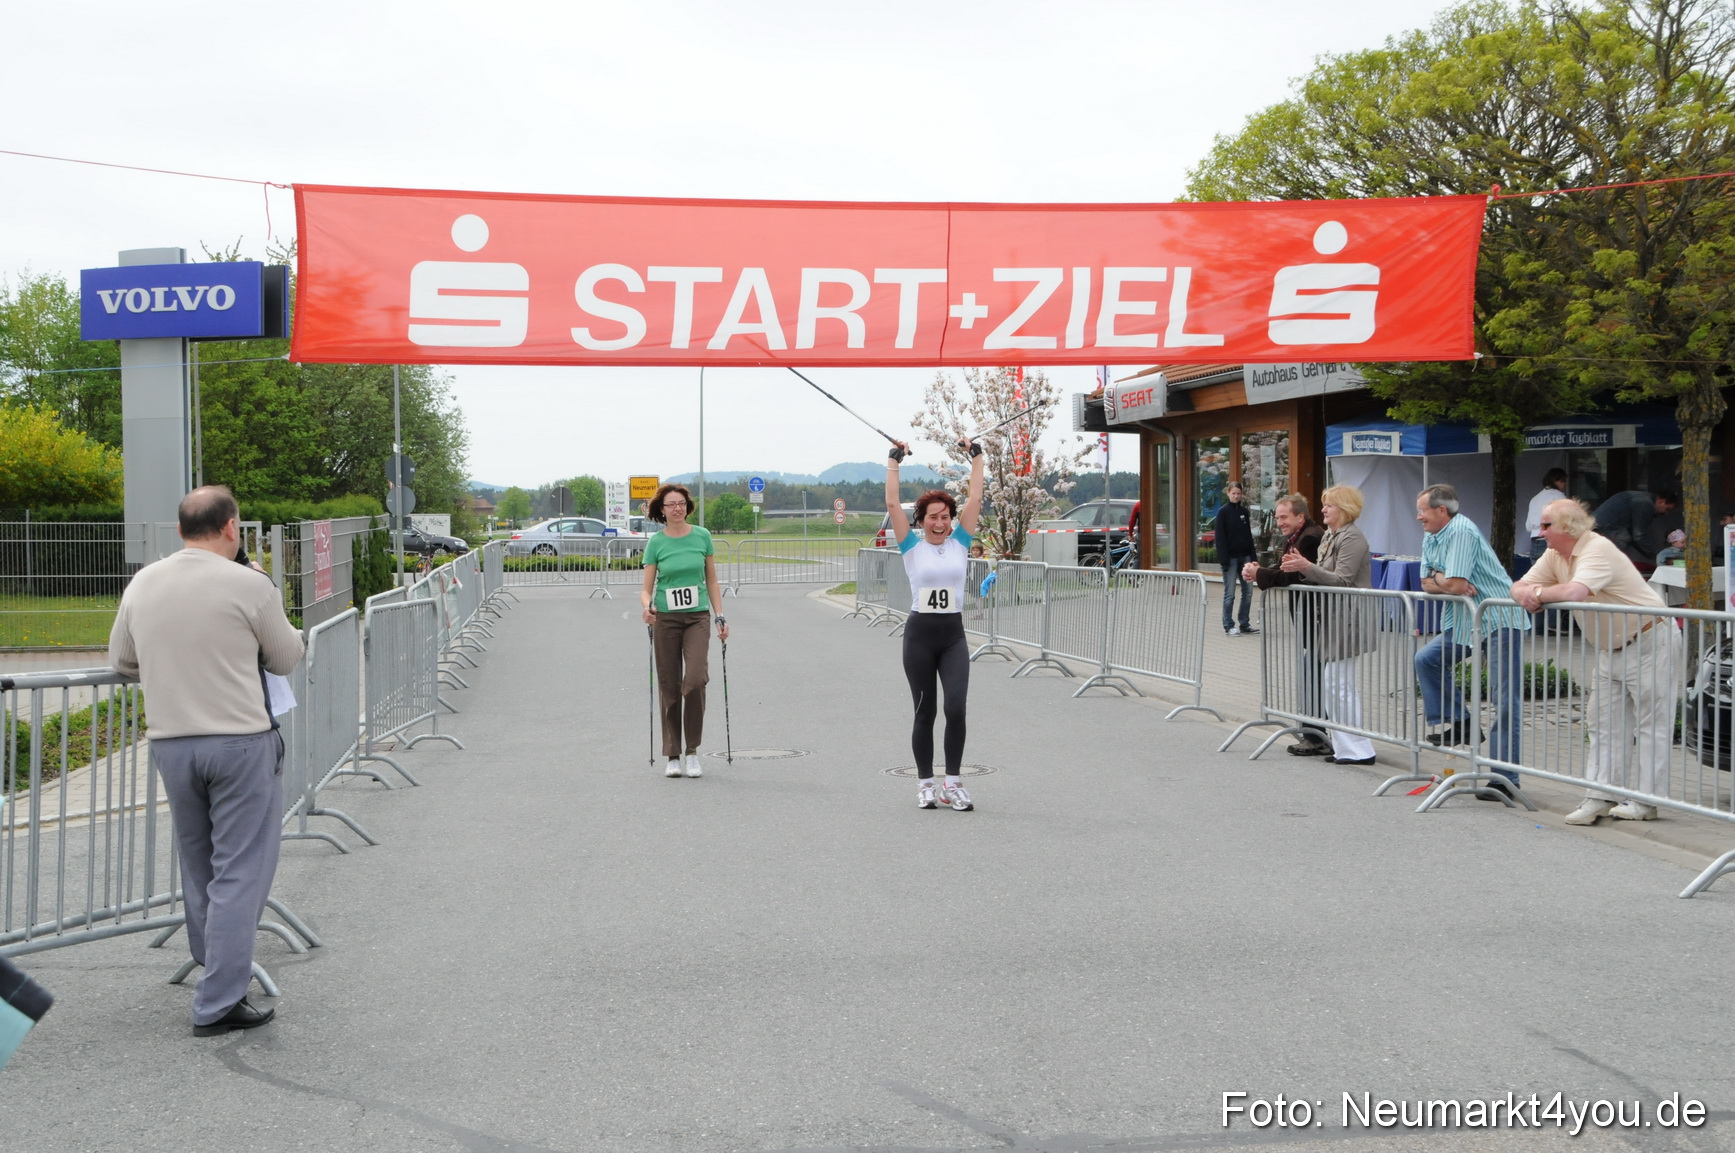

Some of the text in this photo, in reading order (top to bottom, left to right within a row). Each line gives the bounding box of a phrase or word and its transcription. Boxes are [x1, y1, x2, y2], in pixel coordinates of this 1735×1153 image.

[97, 284, 237, 314] VOLVO
[571, 263, 1224, 352] START+ZIEL
[1252, 364, 1298, 388] Autohaus
[1120, 387, 1155, 409] SEAT
[1567, 431, 1608, 445] Tagblatt
[671, 588, 692, 607] 119
[927, 589, 949, 609] 49
